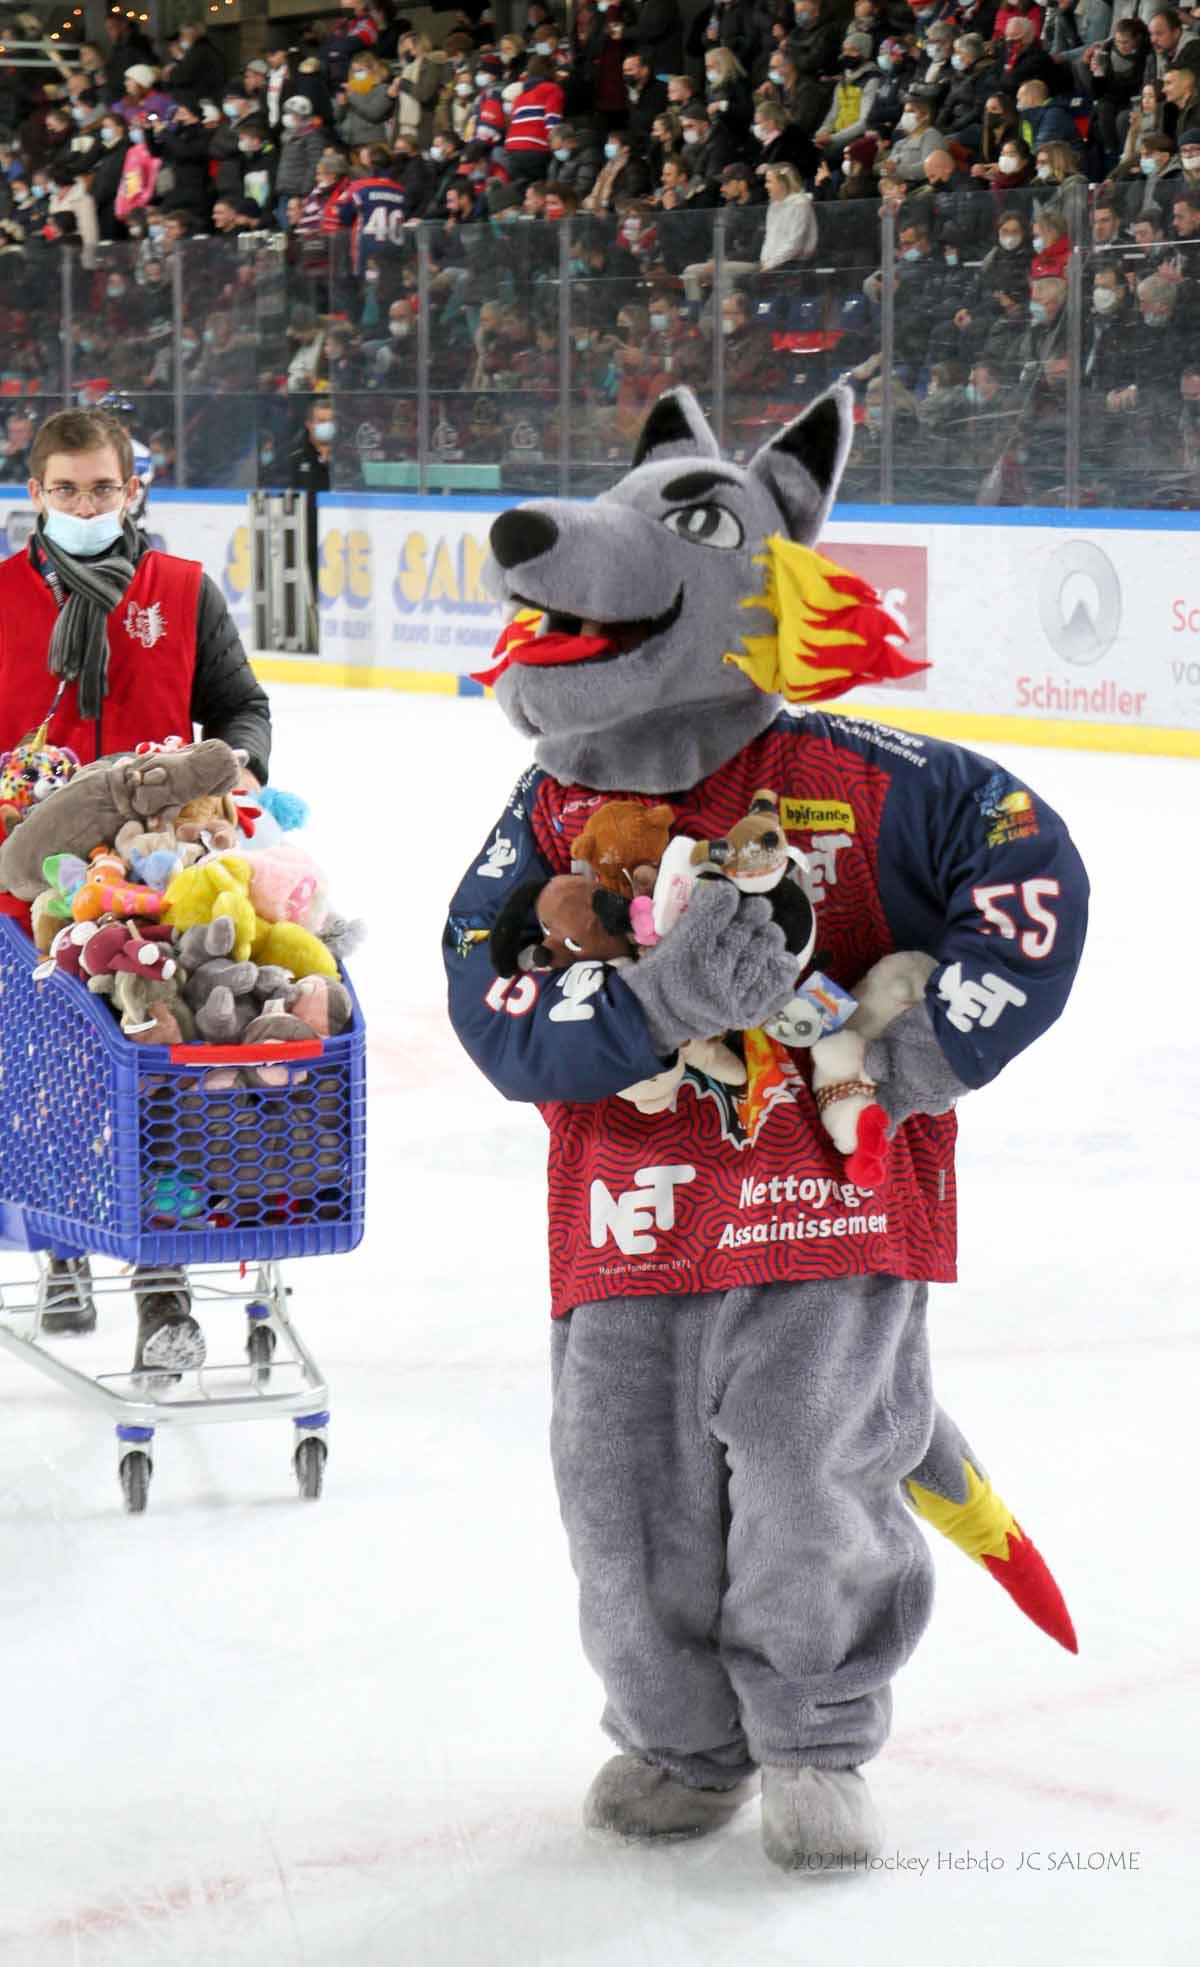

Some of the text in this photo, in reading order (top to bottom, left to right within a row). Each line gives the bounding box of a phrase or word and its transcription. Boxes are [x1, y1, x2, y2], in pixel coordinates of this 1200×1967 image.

[1015, 675, 1148, 715] Schindler
[785, 804, 851, 825] bpifrance
[971, 879, 1061, 961] 55
[936, 961, 1028, 1033] NET
[590, 1164, 697, 1256] NET
